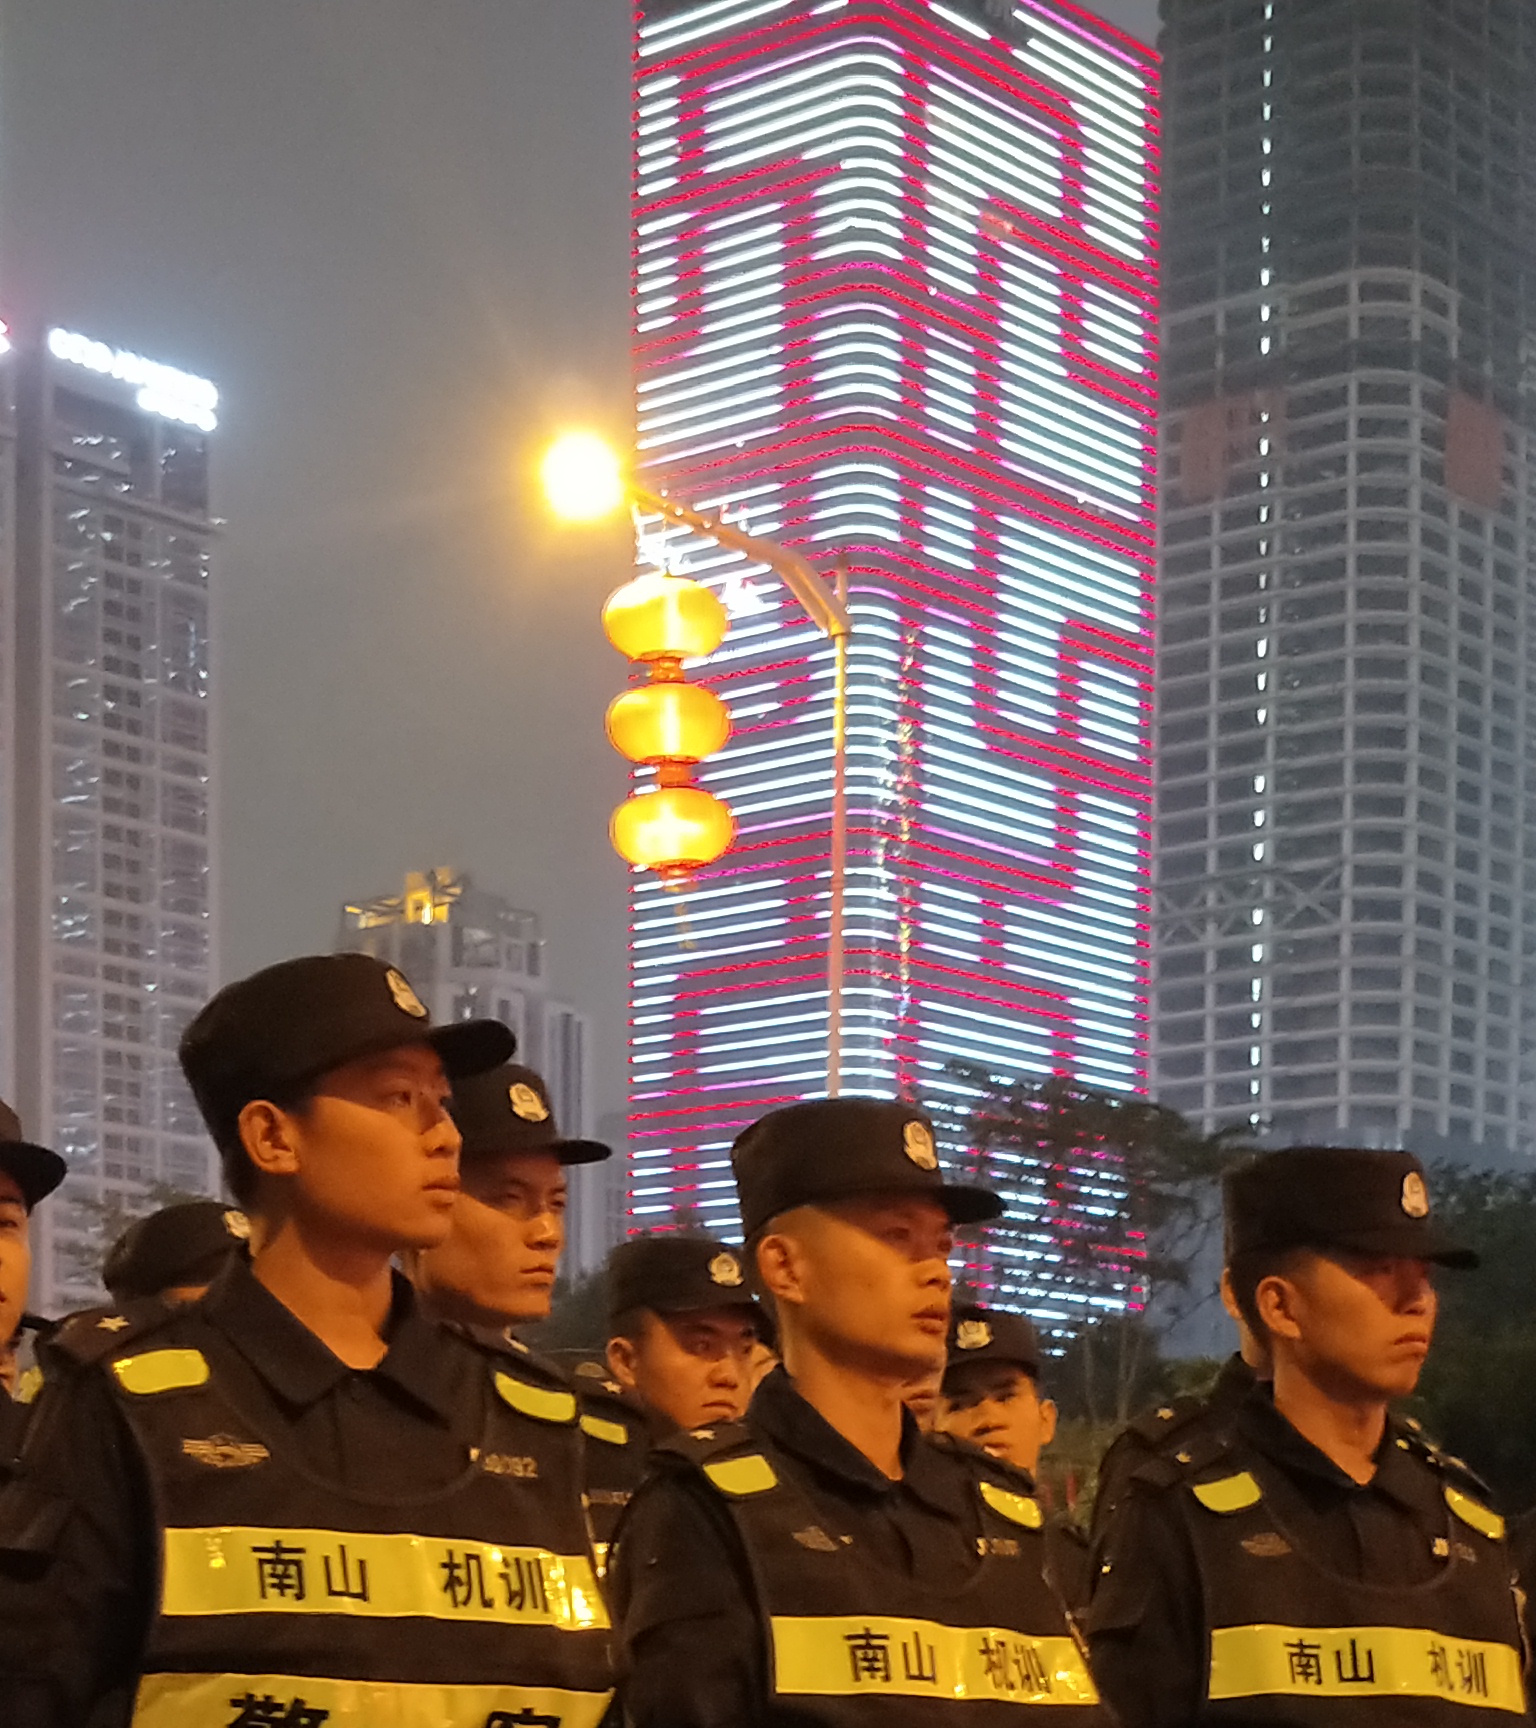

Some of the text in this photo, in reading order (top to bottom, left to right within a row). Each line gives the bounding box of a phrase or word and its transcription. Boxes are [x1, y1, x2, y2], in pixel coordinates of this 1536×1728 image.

[252, 1540, 549, 1614] 南山 机训
[844, 1627, 1052, 1694] 南山 机训
[1284, 1638, 1488, 1698] 南山 机训
